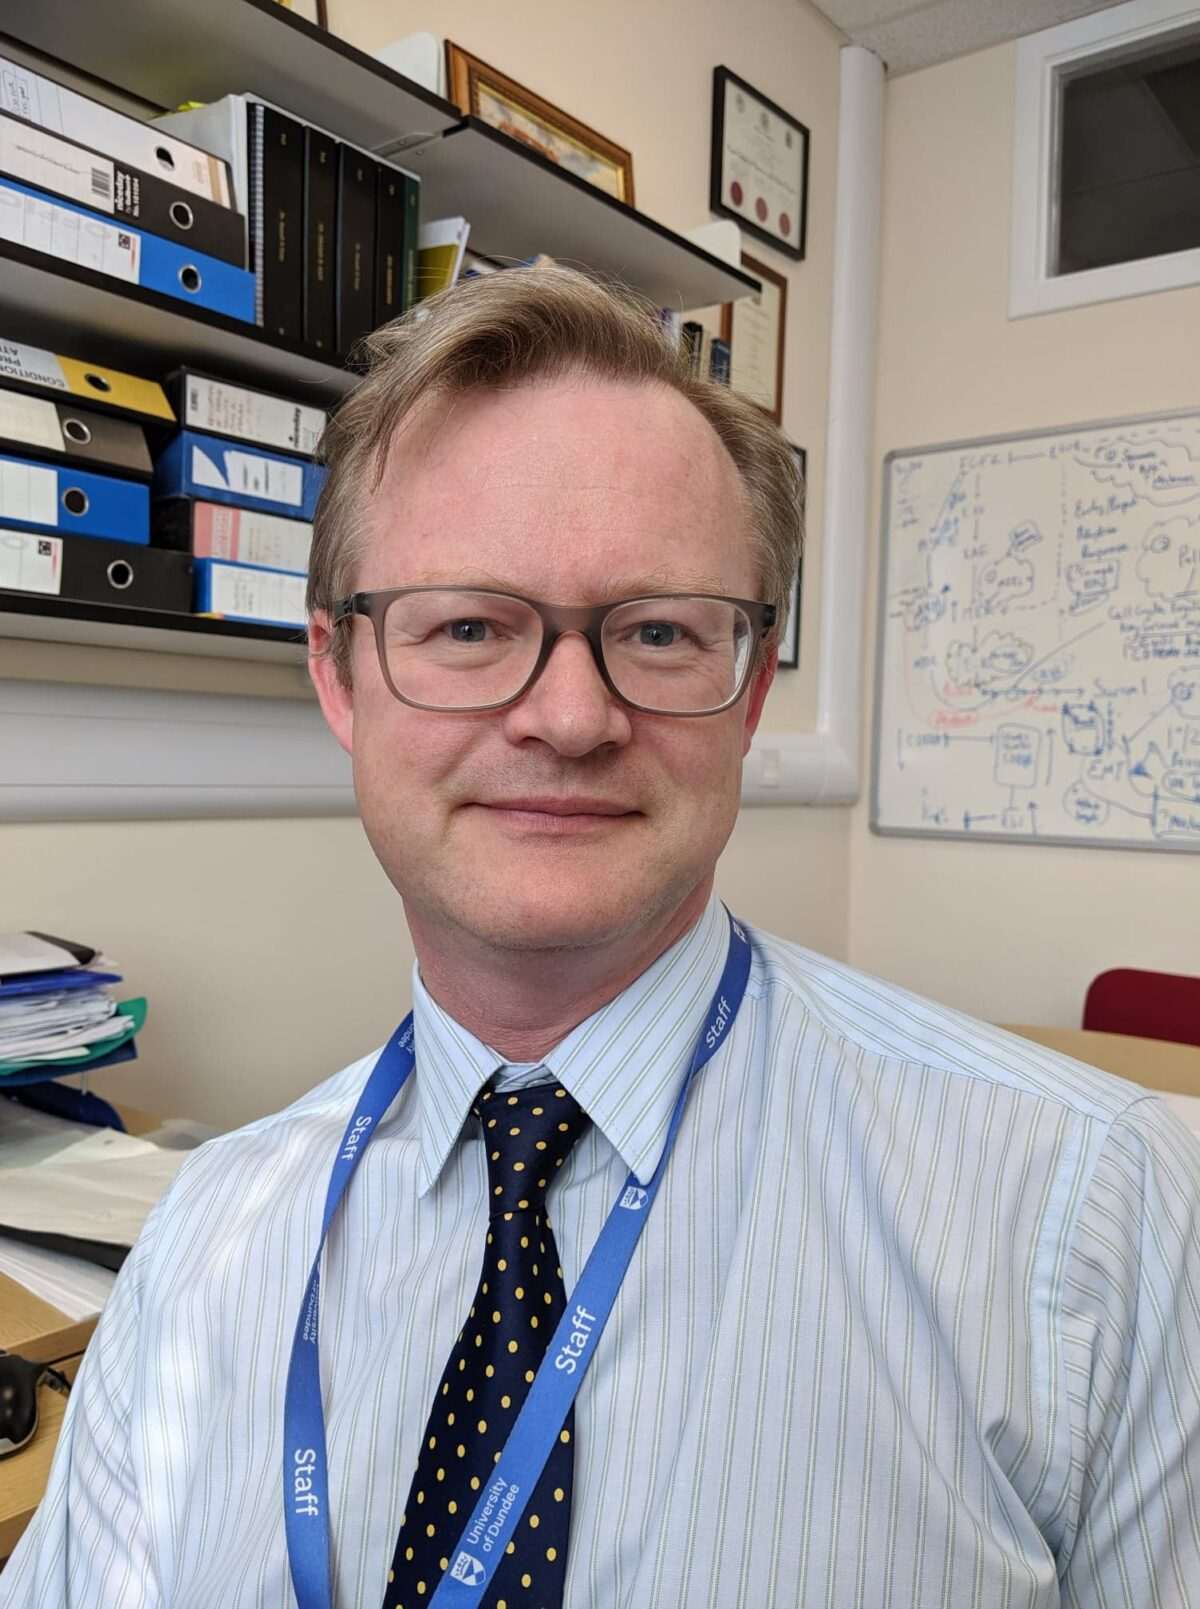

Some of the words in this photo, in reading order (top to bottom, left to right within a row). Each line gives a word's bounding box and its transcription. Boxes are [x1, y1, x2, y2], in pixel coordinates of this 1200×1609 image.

[0, 345, 18, 356] AT
[705, 996, 731, 1048] Staff
[341, 1115, 372, 1161] Staff
[555, 1304, 596, 1375] Staff
[294, 1448, 319, 1516] Staff
[466, 1477, 508, 1545] University
[488, 1484, 519, 1537] Dundee
[482, 1534, 495, 1552] of
